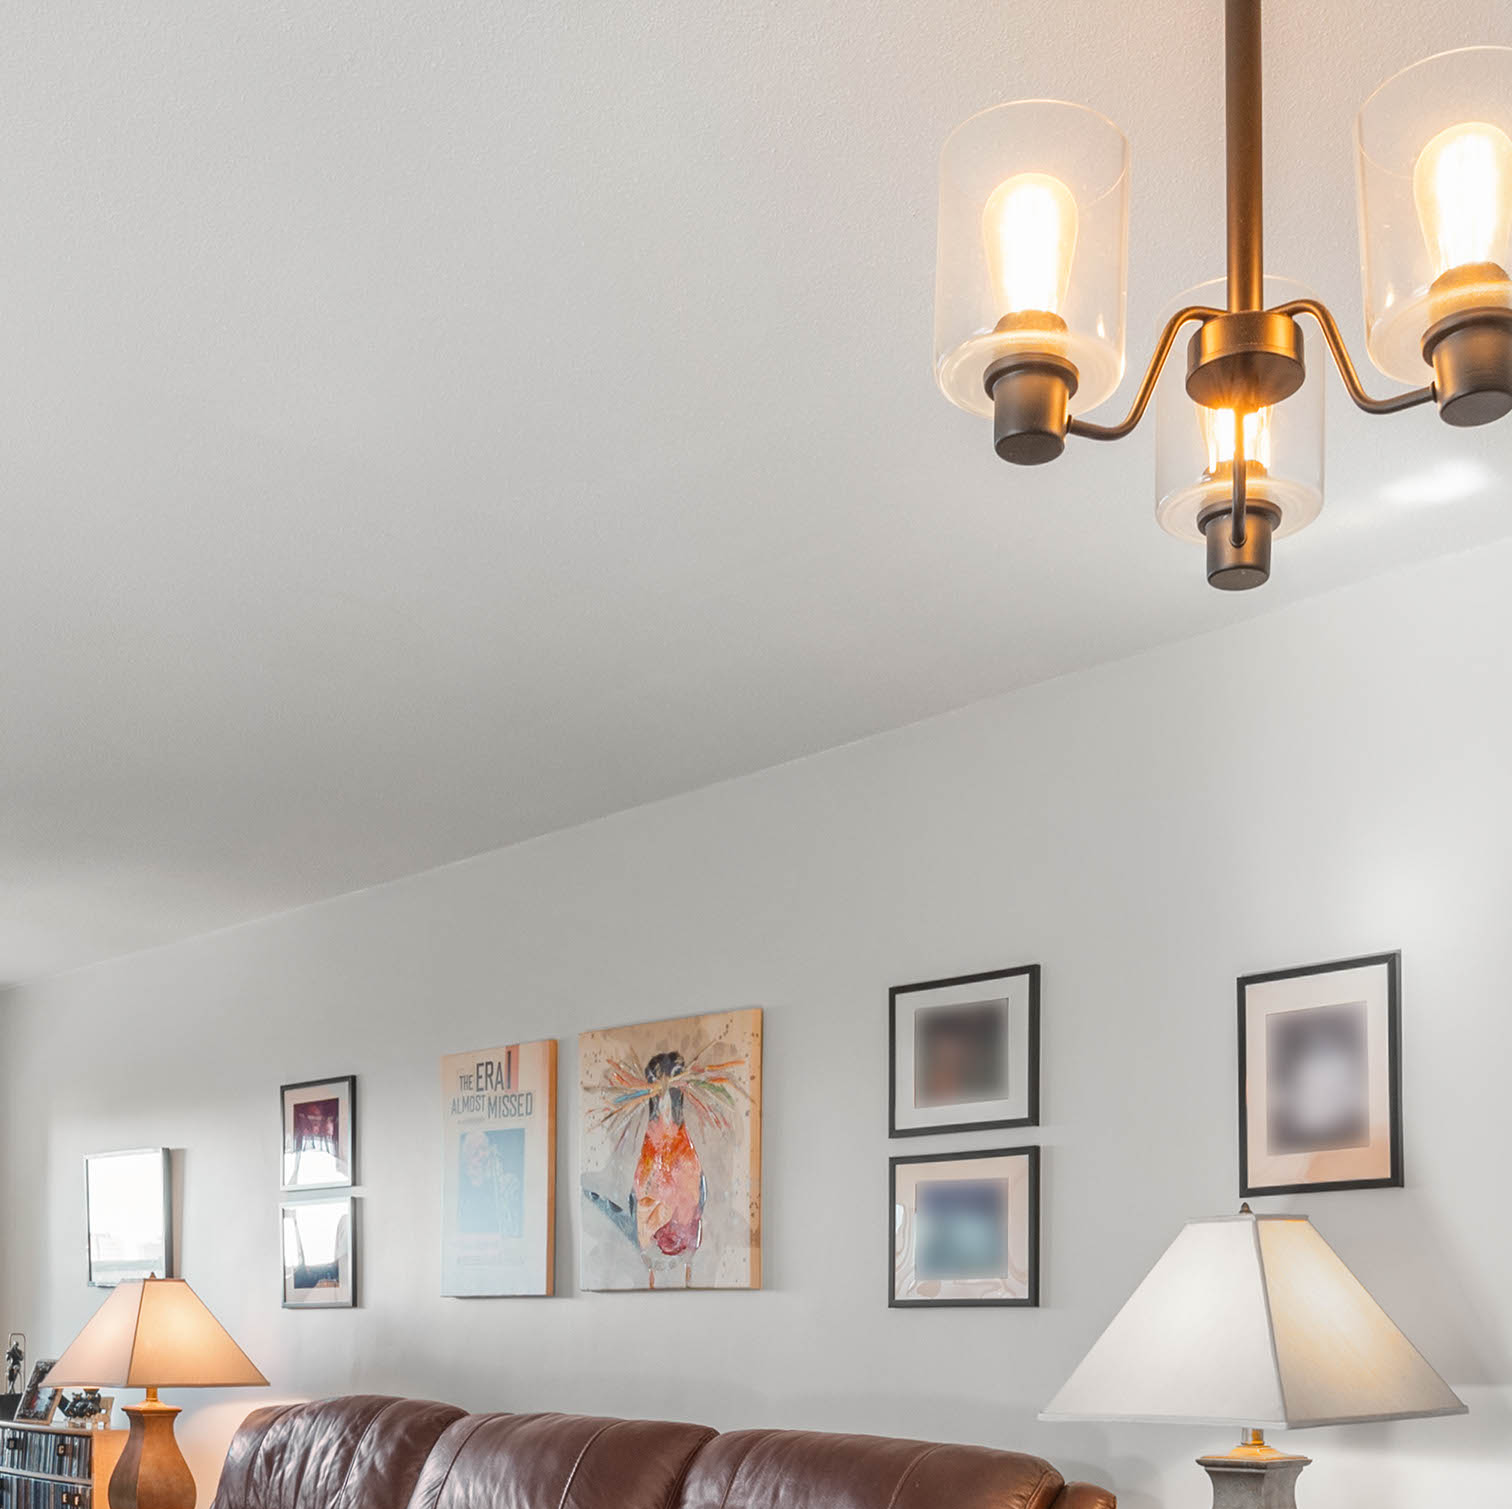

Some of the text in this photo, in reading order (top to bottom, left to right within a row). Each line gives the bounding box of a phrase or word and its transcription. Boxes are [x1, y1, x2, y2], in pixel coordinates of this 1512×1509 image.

[459, 1050, 512, 1092] THE ERA I
[451, 1092, 533, 1119] ALMOST MISSED
